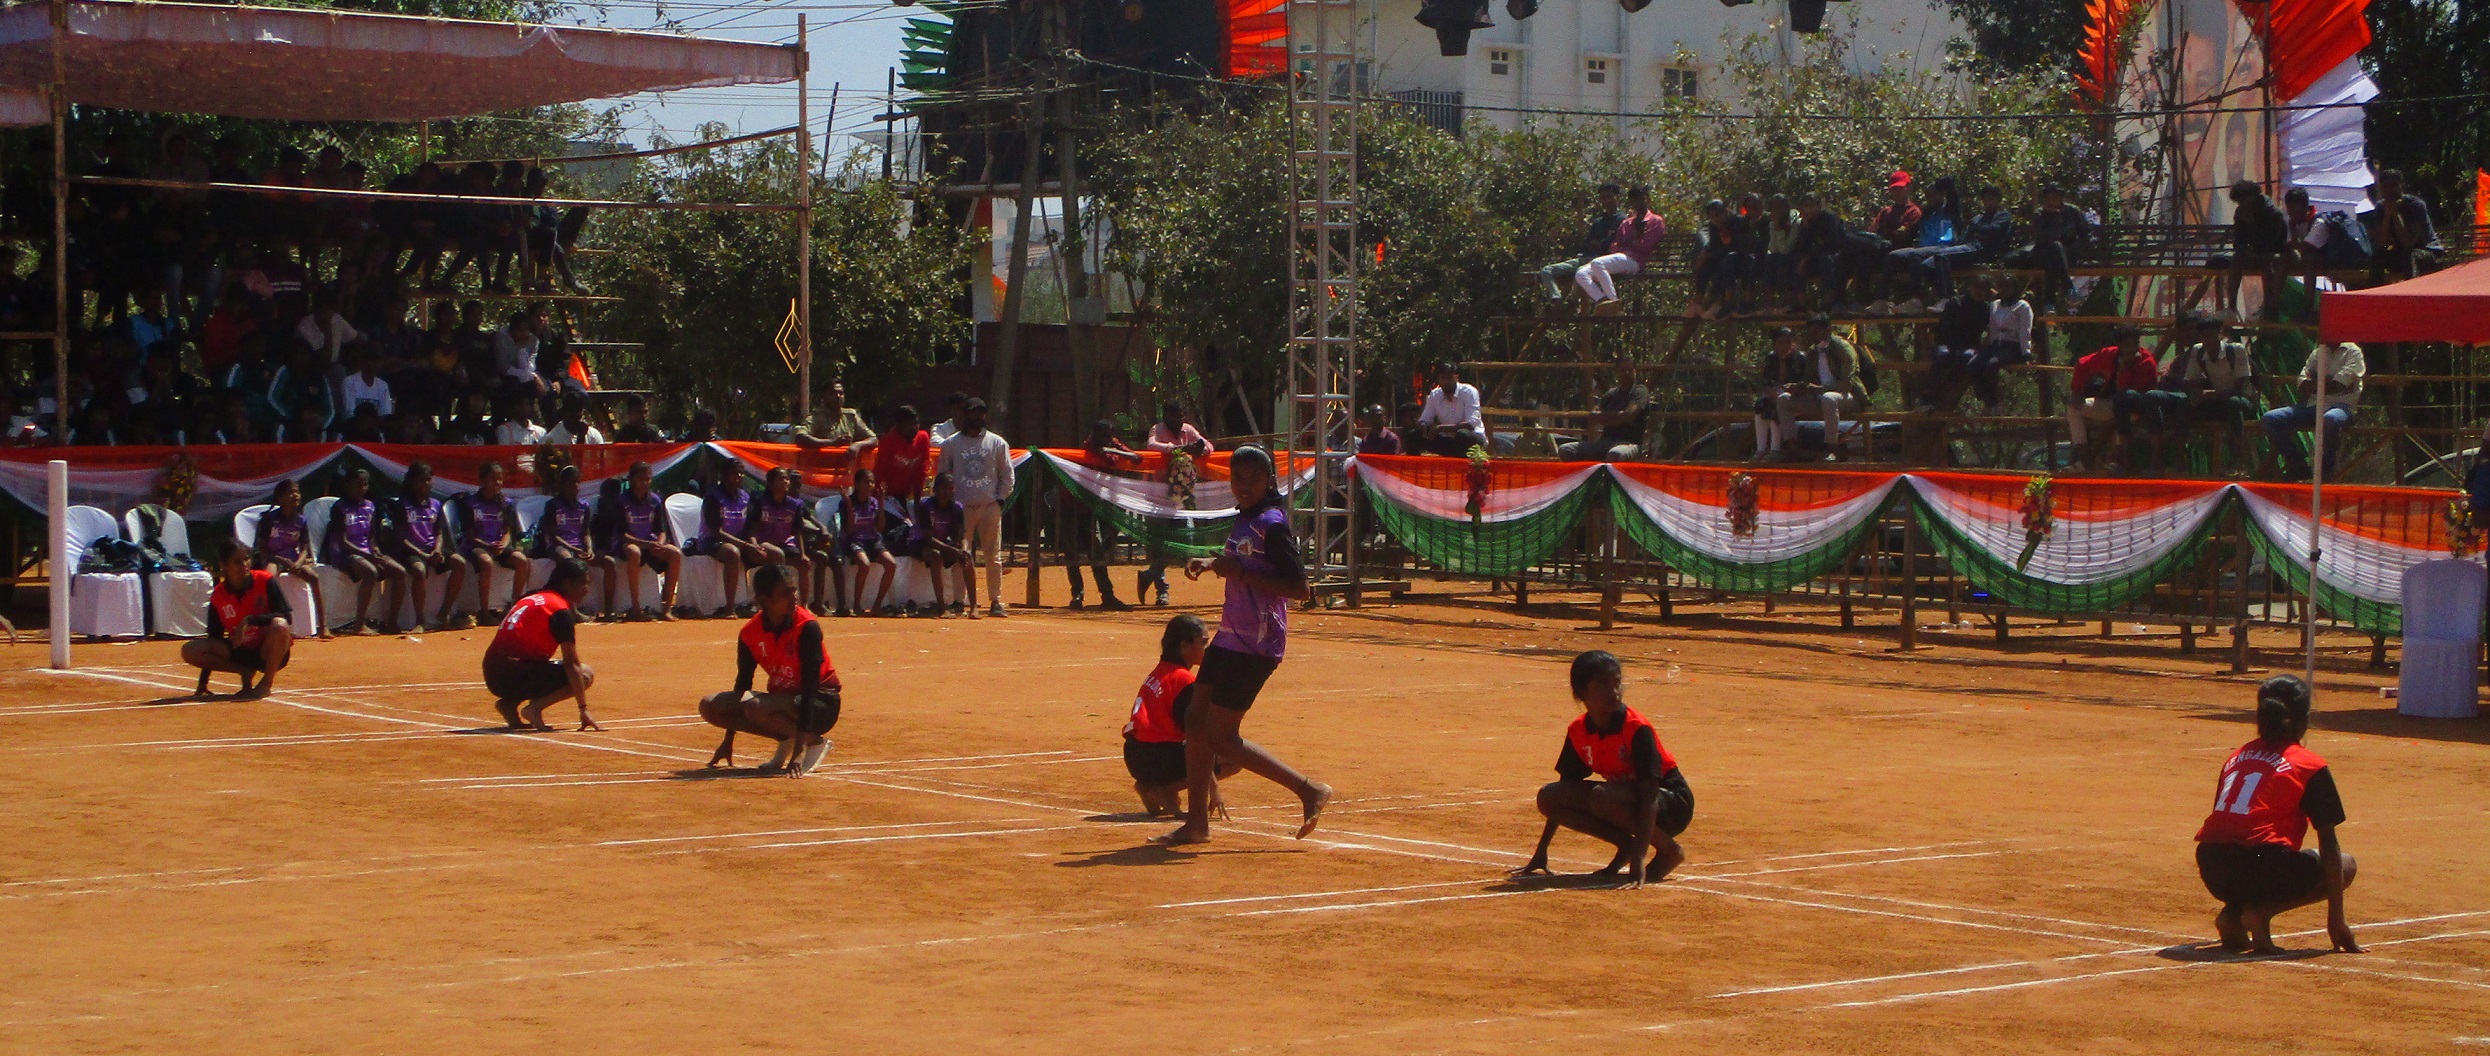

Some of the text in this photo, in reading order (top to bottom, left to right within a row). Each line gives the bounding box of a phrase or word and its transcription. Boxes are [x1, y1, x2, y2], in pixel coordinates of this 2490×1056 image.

[961, 446, 988, 459] NEW
[960, 475, 991, 488] YORK
[222, 604, 237, 619] 10
[2213, 770, 2263, 815] 11
